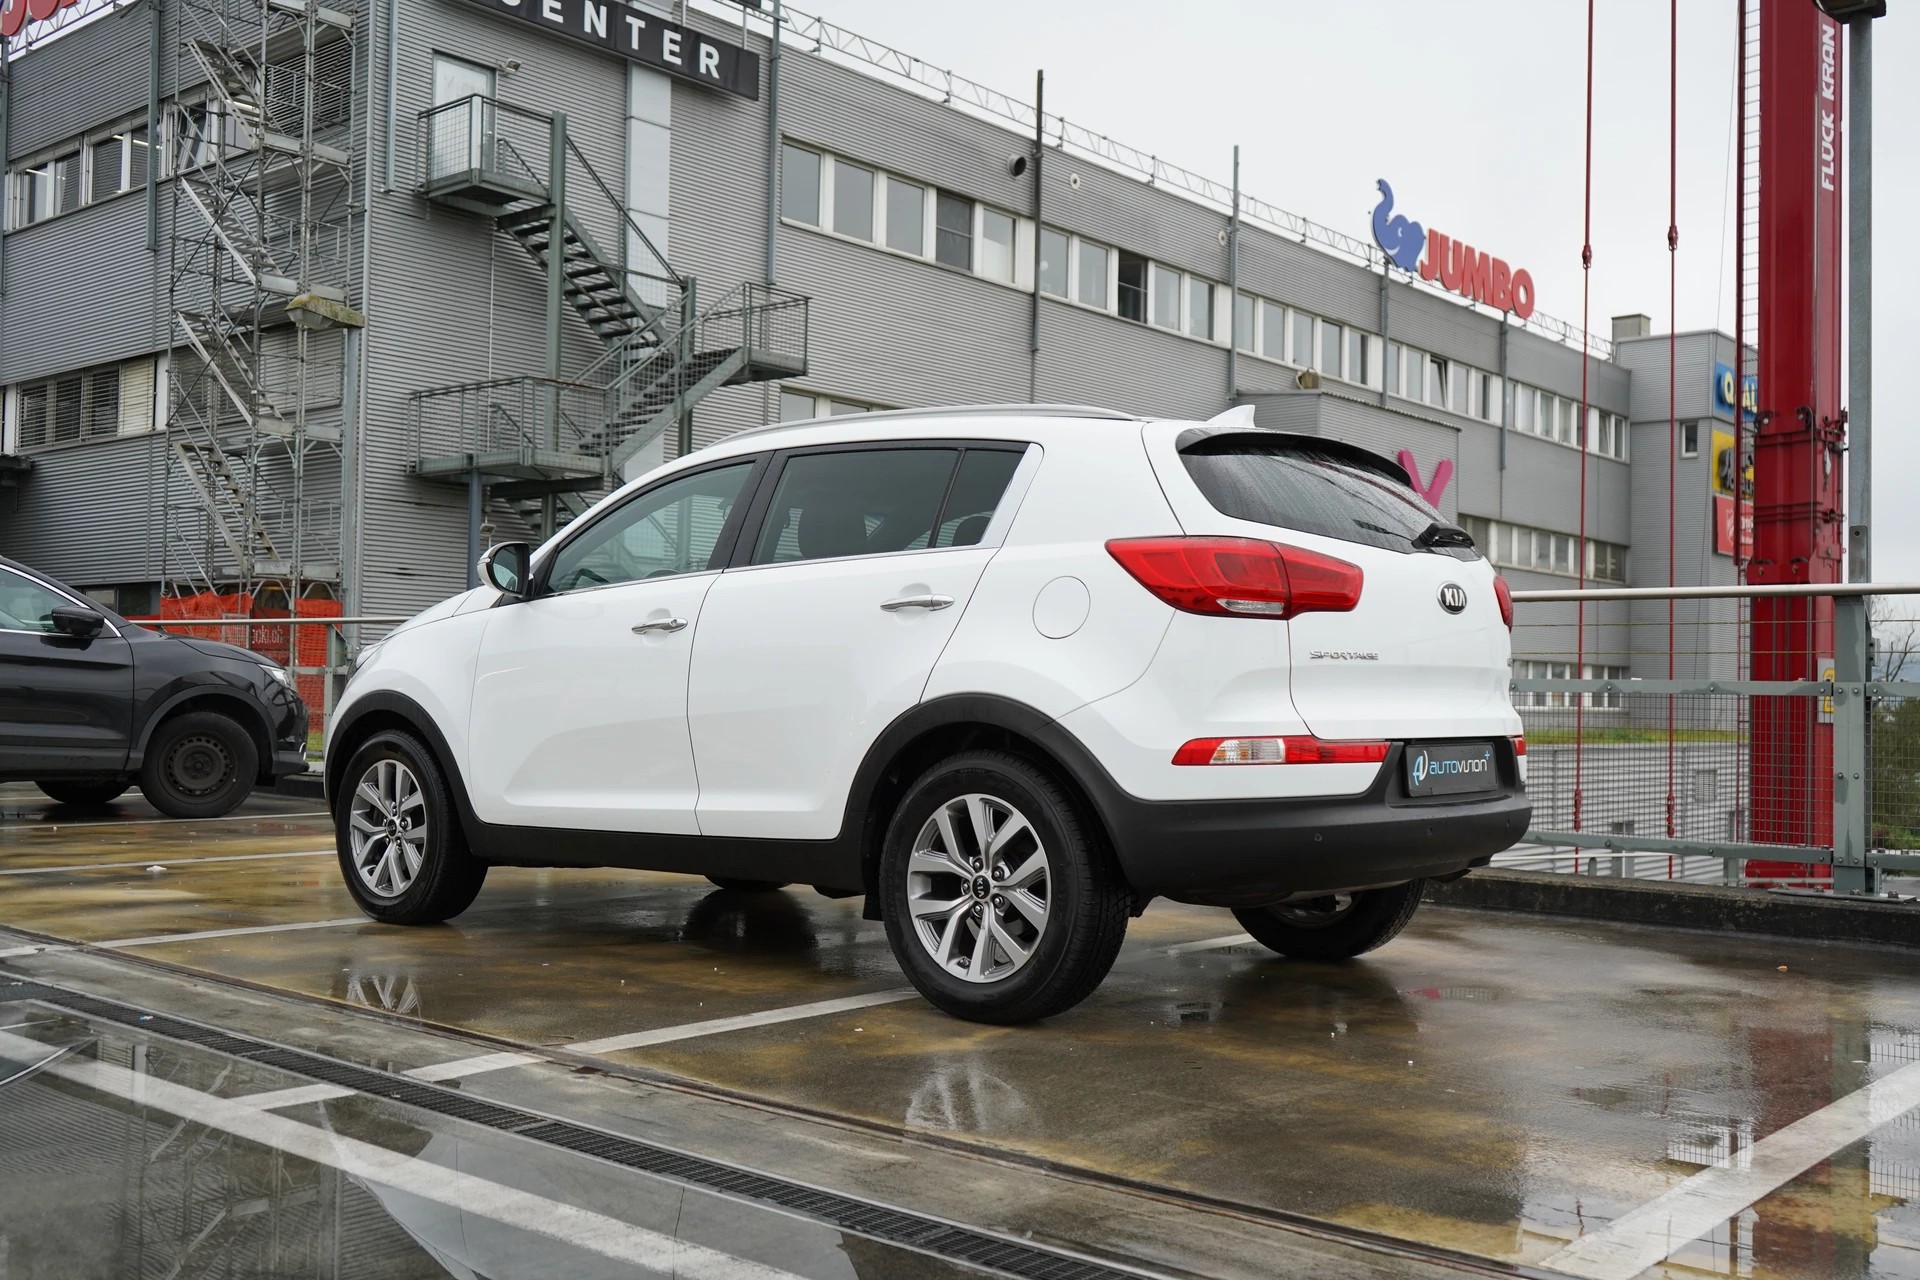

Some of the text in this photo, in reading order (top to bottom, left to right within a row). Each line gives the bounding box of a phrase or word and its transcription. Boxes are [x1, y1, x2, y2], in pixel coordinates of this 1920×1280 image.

[505, 0, 720, 79] ENTER
[1822, 23, 1836, 101] KRAN
[1419, 228, 1535, 320] JUMBO
[1443, 587, 1467, 607] KIA
[1309, 650, 1379, 661] SPORTAGE
[976, 877, 985, 898] KIA
